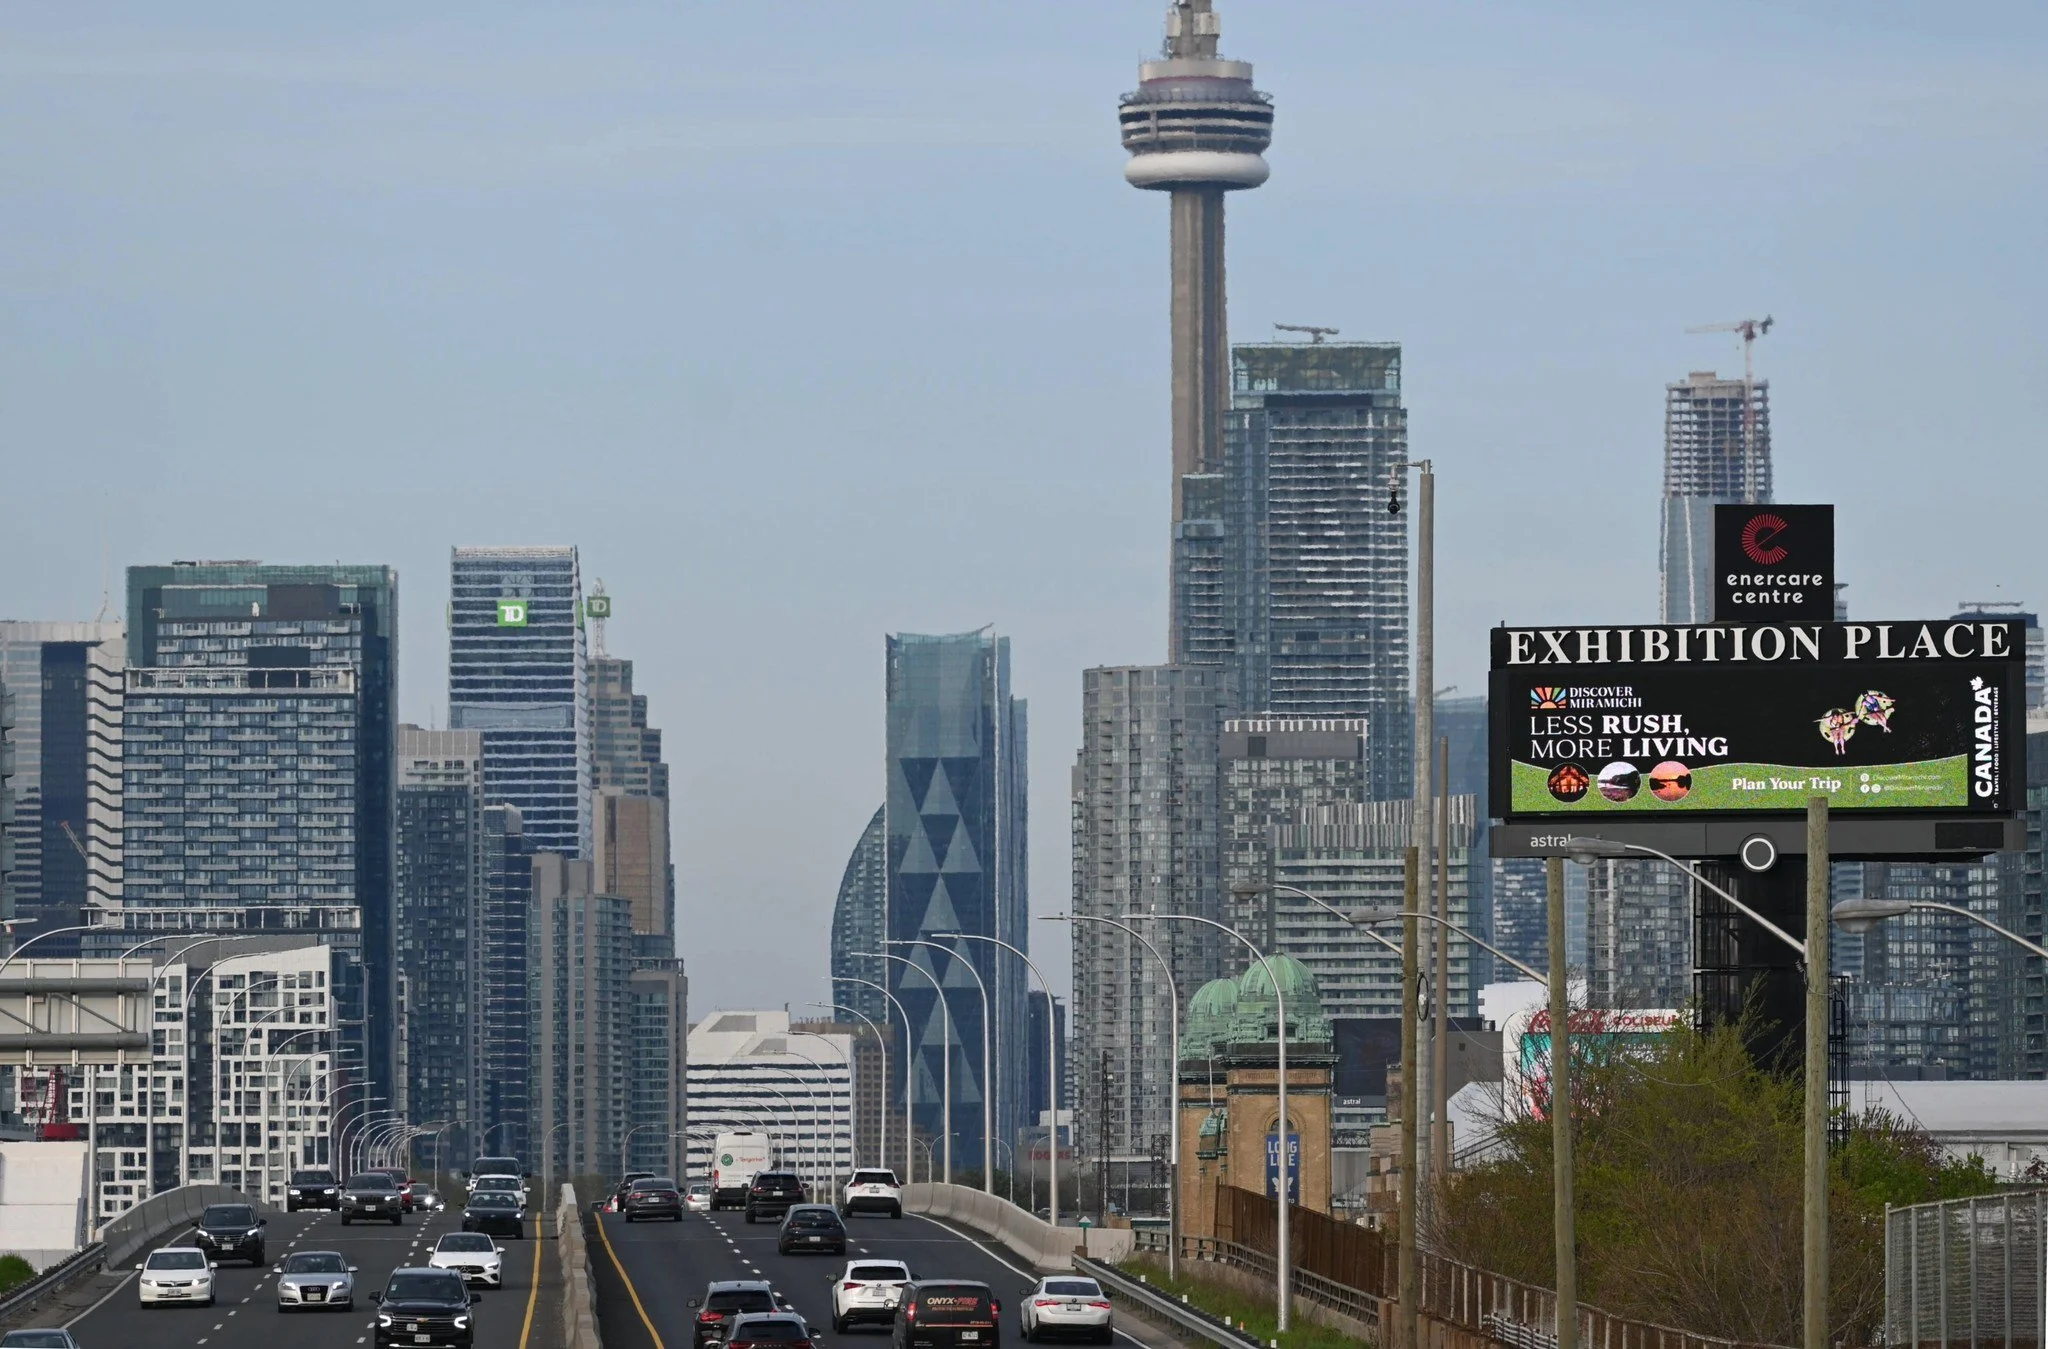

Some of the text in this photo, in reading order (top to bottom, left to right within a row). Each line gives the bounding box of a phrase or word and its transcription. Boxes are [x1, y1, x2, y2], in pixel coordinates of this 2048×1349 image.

[1727, 574, 1823, 586] enercare
[1732, 590, 1803, 604] centre
[589, 599, 607, 612] TD
[500, 605, 525, 622] TD
[1507, 622, 2011, 665] EXHIBITION PLACE
[1569, 686, 1633, 698] DISCOVER
[1569, 697, 1642, 709] MIRAMICHI
[1530, 713, 1690, 736] LESS RUSH,
[1530, 736, 1729, 759] MORE LIVING
[1974, 686, 1993, 798] CANADA
[1732, 776, 1842, 793] Plan Your Trip
[1342, 1098, 1361, 1106] astral
[1027, 1149, 1071, 1161] ROGRS
[1270, 1154, 1296, 1167] LIE
